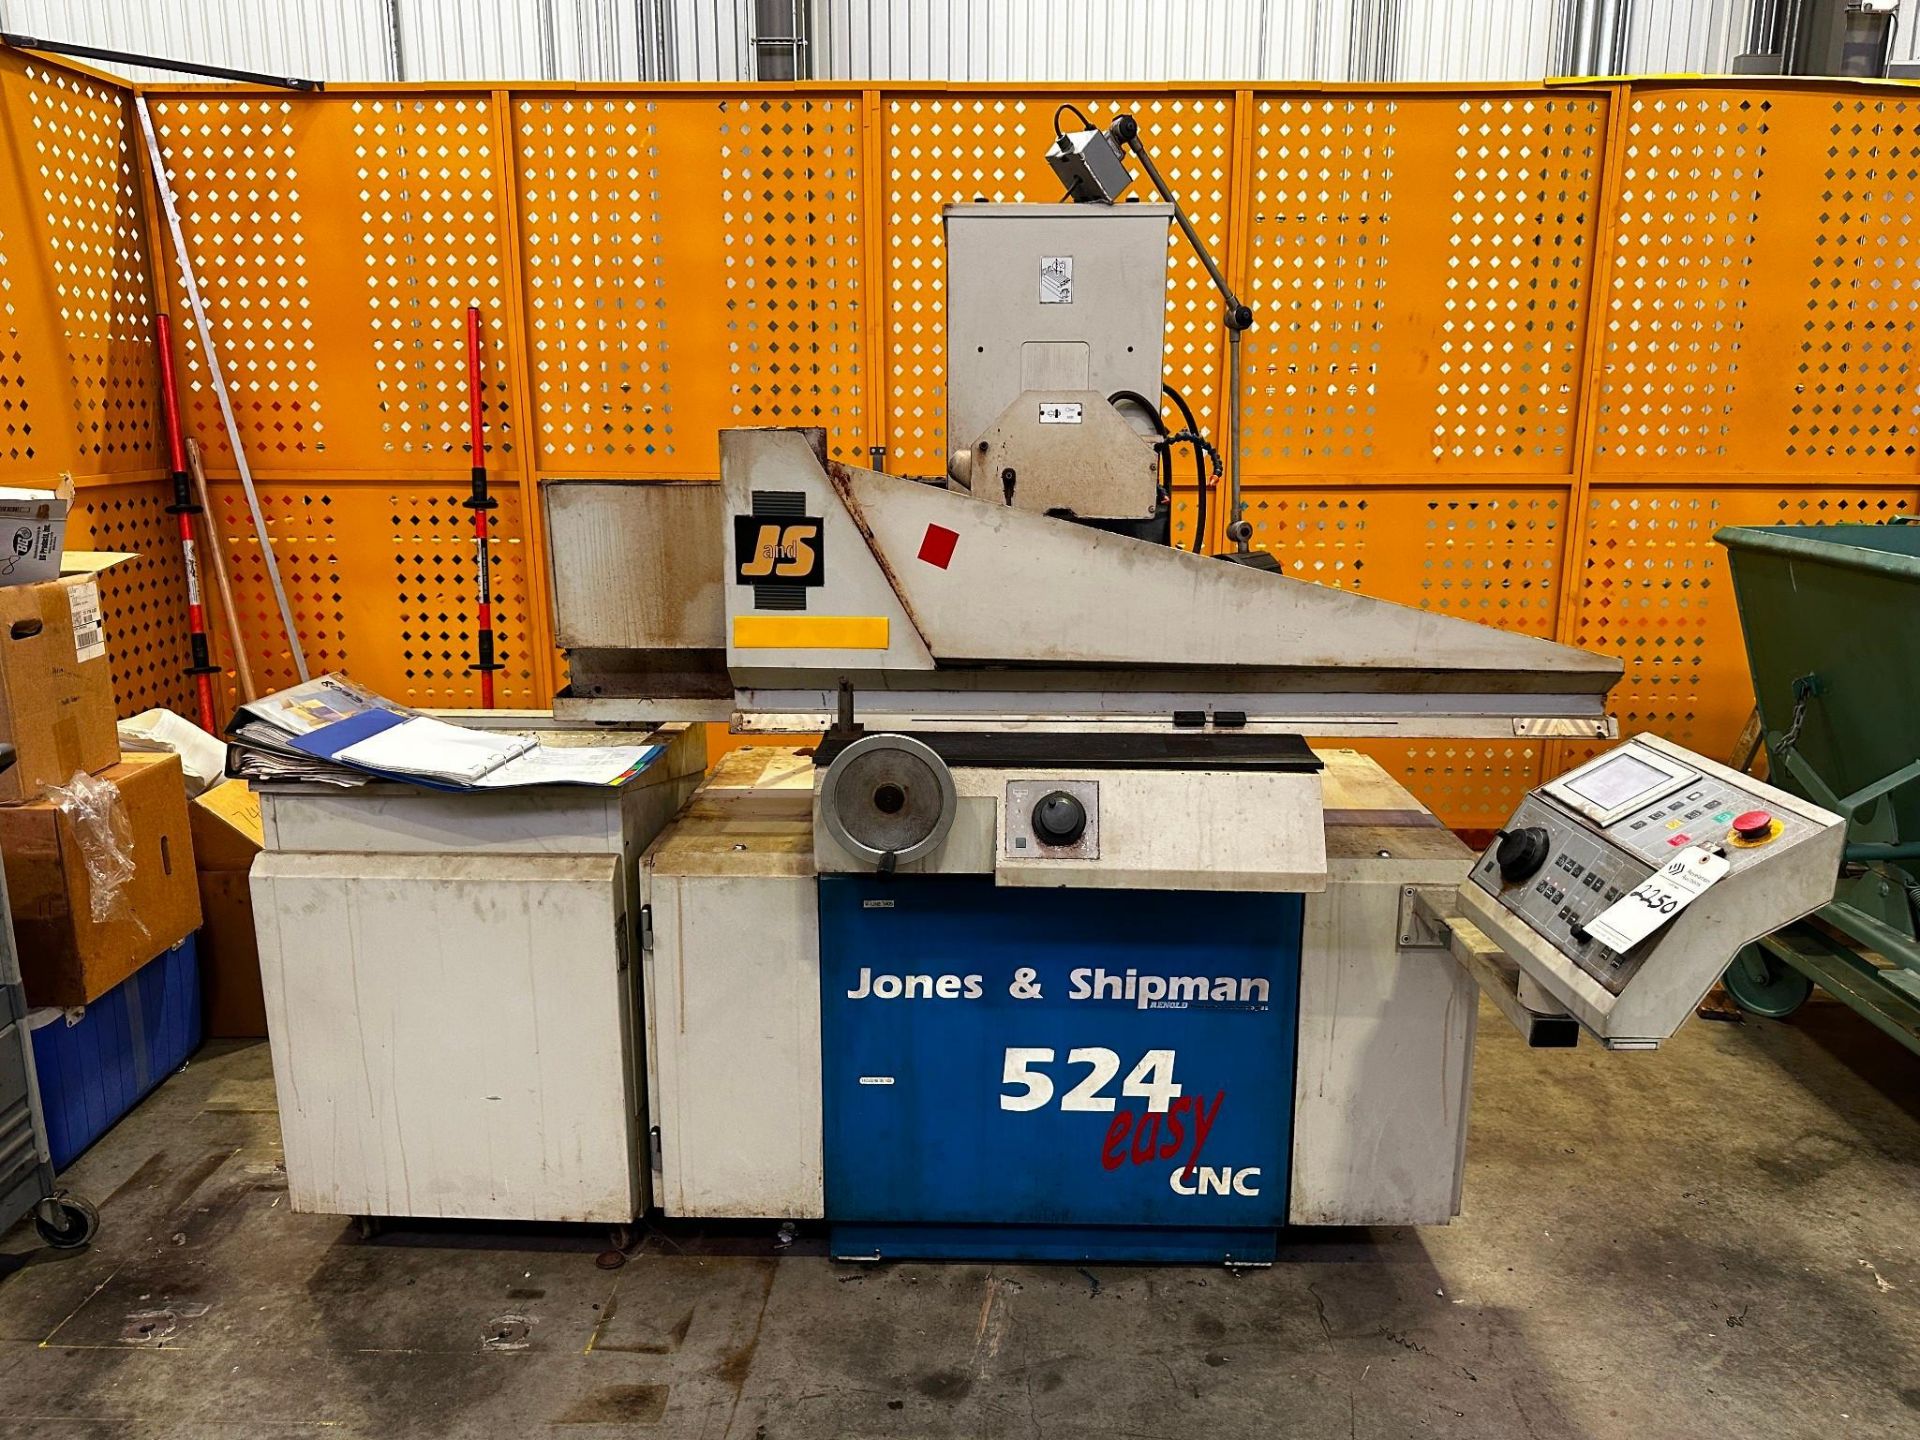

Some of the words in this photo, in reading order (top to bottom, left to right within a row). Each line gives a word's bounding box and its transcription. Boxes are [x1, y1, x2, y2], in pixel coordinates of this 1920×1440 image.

[1630, 884, 1678, 914] 2250
[847, 967, 983, 999] Jones
[1009, 967, 1043, 999] &
[1068, 967, 1270, 1009] Shipman
[1000, 1047, 1183, 1113] 524
[1101, 1090, 1225, 1179] easy
[1169, 1166, 1261, 1197] CNC
